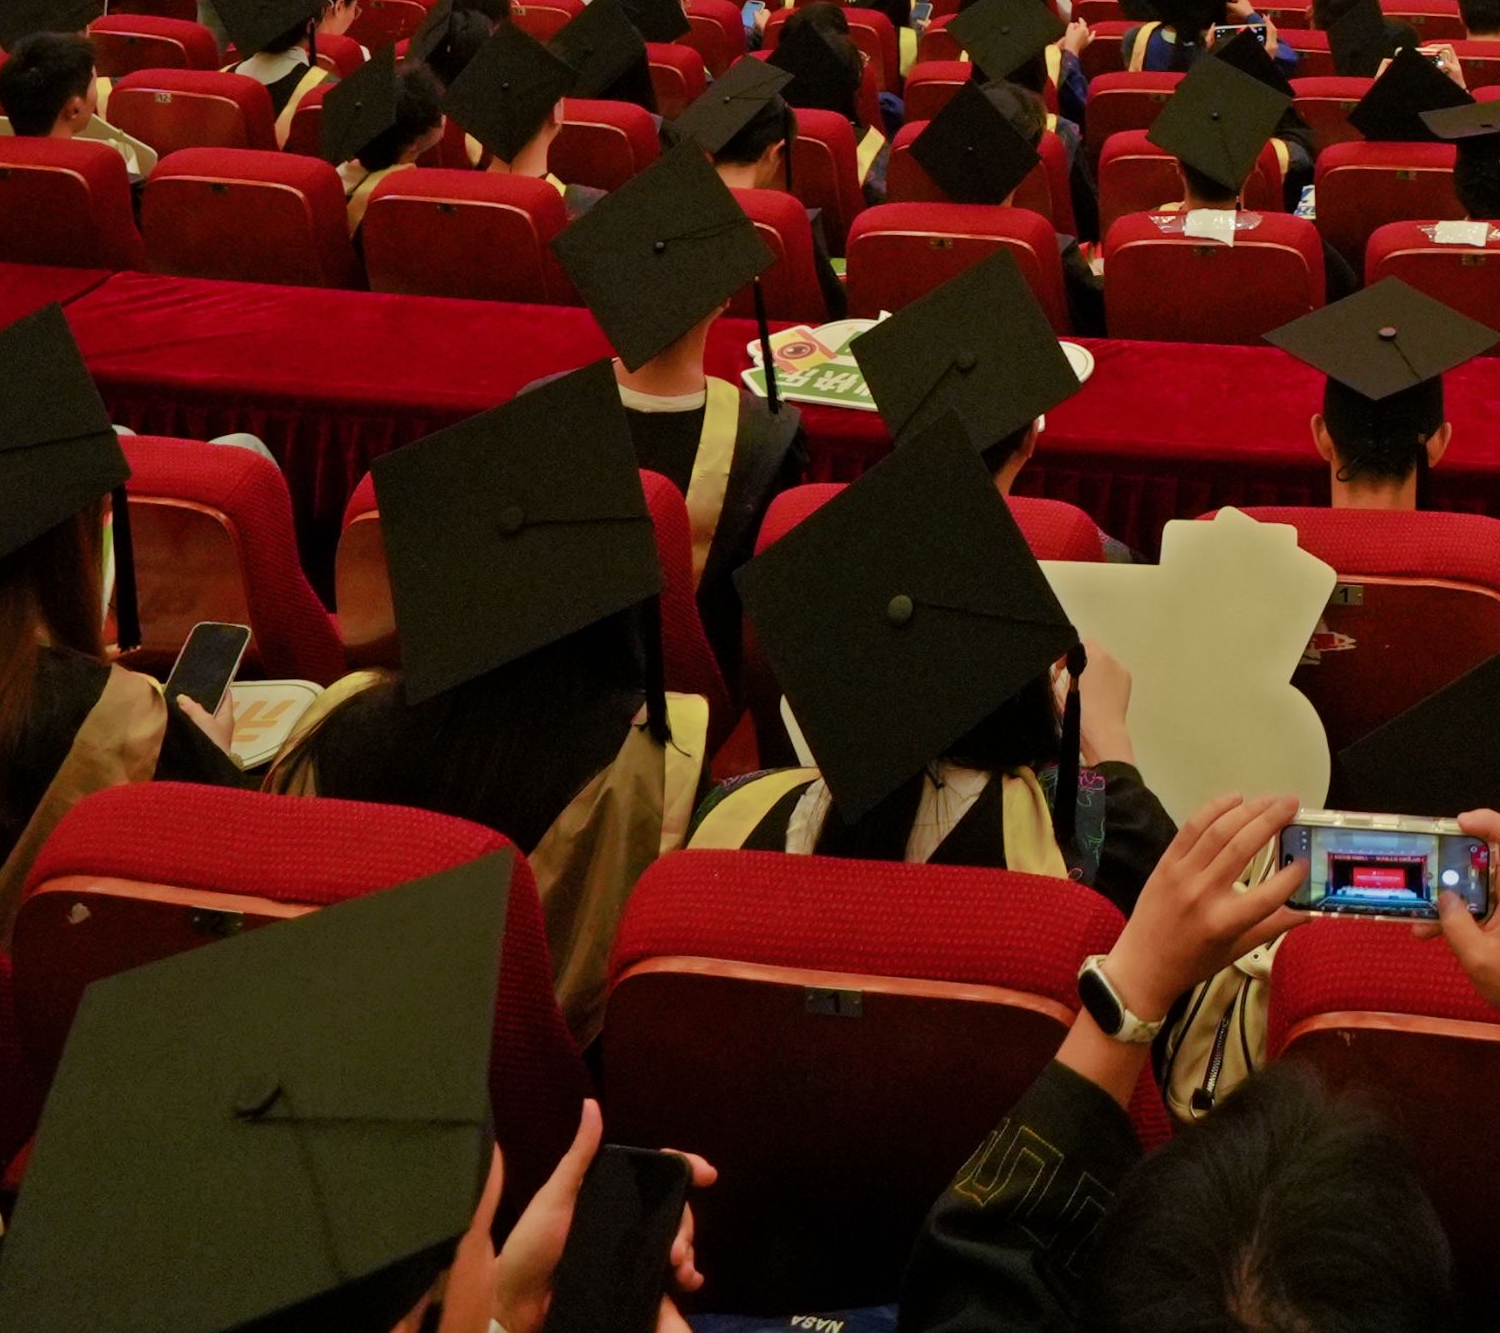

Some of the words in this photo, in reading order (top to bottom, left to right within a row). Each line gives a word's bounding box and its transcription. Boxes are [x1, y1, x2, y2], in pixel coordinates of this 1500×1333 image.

[776, 368, 872, 396] 快乐
[1338, 587, 1349, 603] 1
[827, 991, 841, 1013] 1
[791, 1315, 845, 1333] NASA
